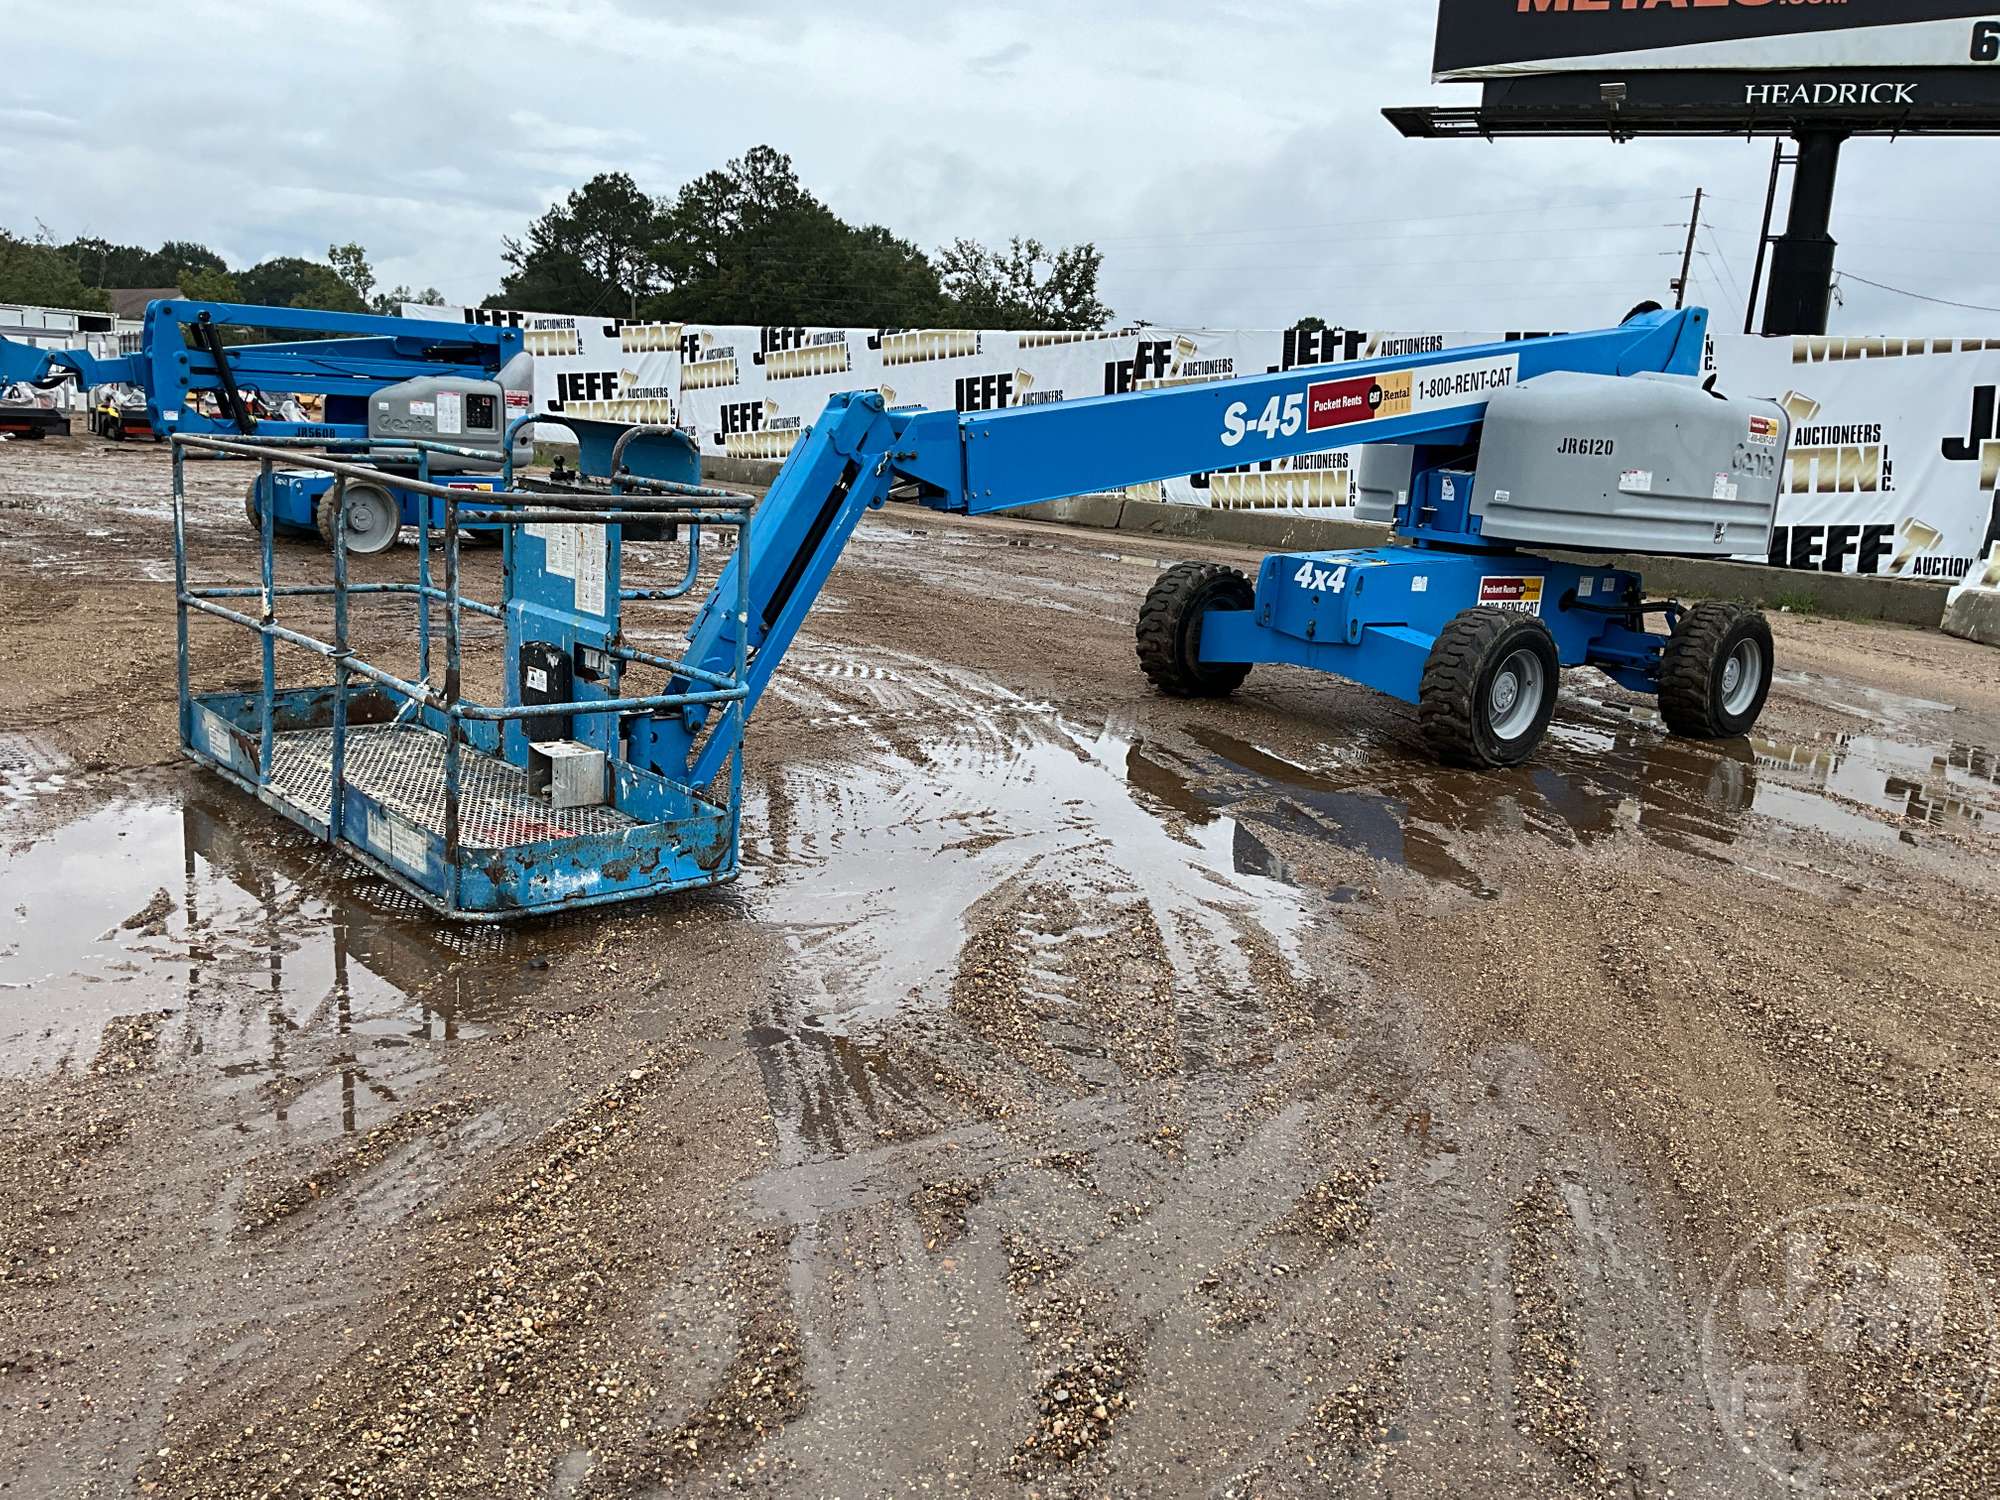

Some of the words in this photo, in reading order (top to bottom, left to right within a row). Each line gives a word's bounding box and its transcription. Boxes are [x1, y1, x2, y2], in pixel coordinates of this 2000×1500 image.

[1745, 83, 1918, 104] HEADRICK
[534, 318, 575, 330] AUCTIONEERS
[813, 331, 845, 344] AUCTIONEERS
[1381, 336, 1443, 357] AUCTIONEERS
[1182, 358, 1233, 377] AUCTIONEERS
[548, 372, 618, 412] JEFF
[627, 387, 668, 399] AUCTIONEERS
[1022, 390, 1064, 406] AUCTIONEERS
[1314, 398, 1342, 412] Puckett
[1342, 395, 1362, 407] Rents
[1369, 391, 1381, 403] CAT
[1383, 387, 1410, 401] Rental
[1418, 367, 1512, 399] 1-800-RENT-CAT
[714, 402, 763, 445] JEFF
[769, 416, 801, 430] AUCTIONEERS
[1220, 392, 1304, 448] S-45
[1795, 424, 1881, 446] AUCTIONEERS
[1557, 437, 1614, 456] JR6120
[1293, 453, 1349, 470] AUCTIONEERS
[1210, 471, 1347, 509] MARTIN
[1294, 561, 1347, 594] 4x4
